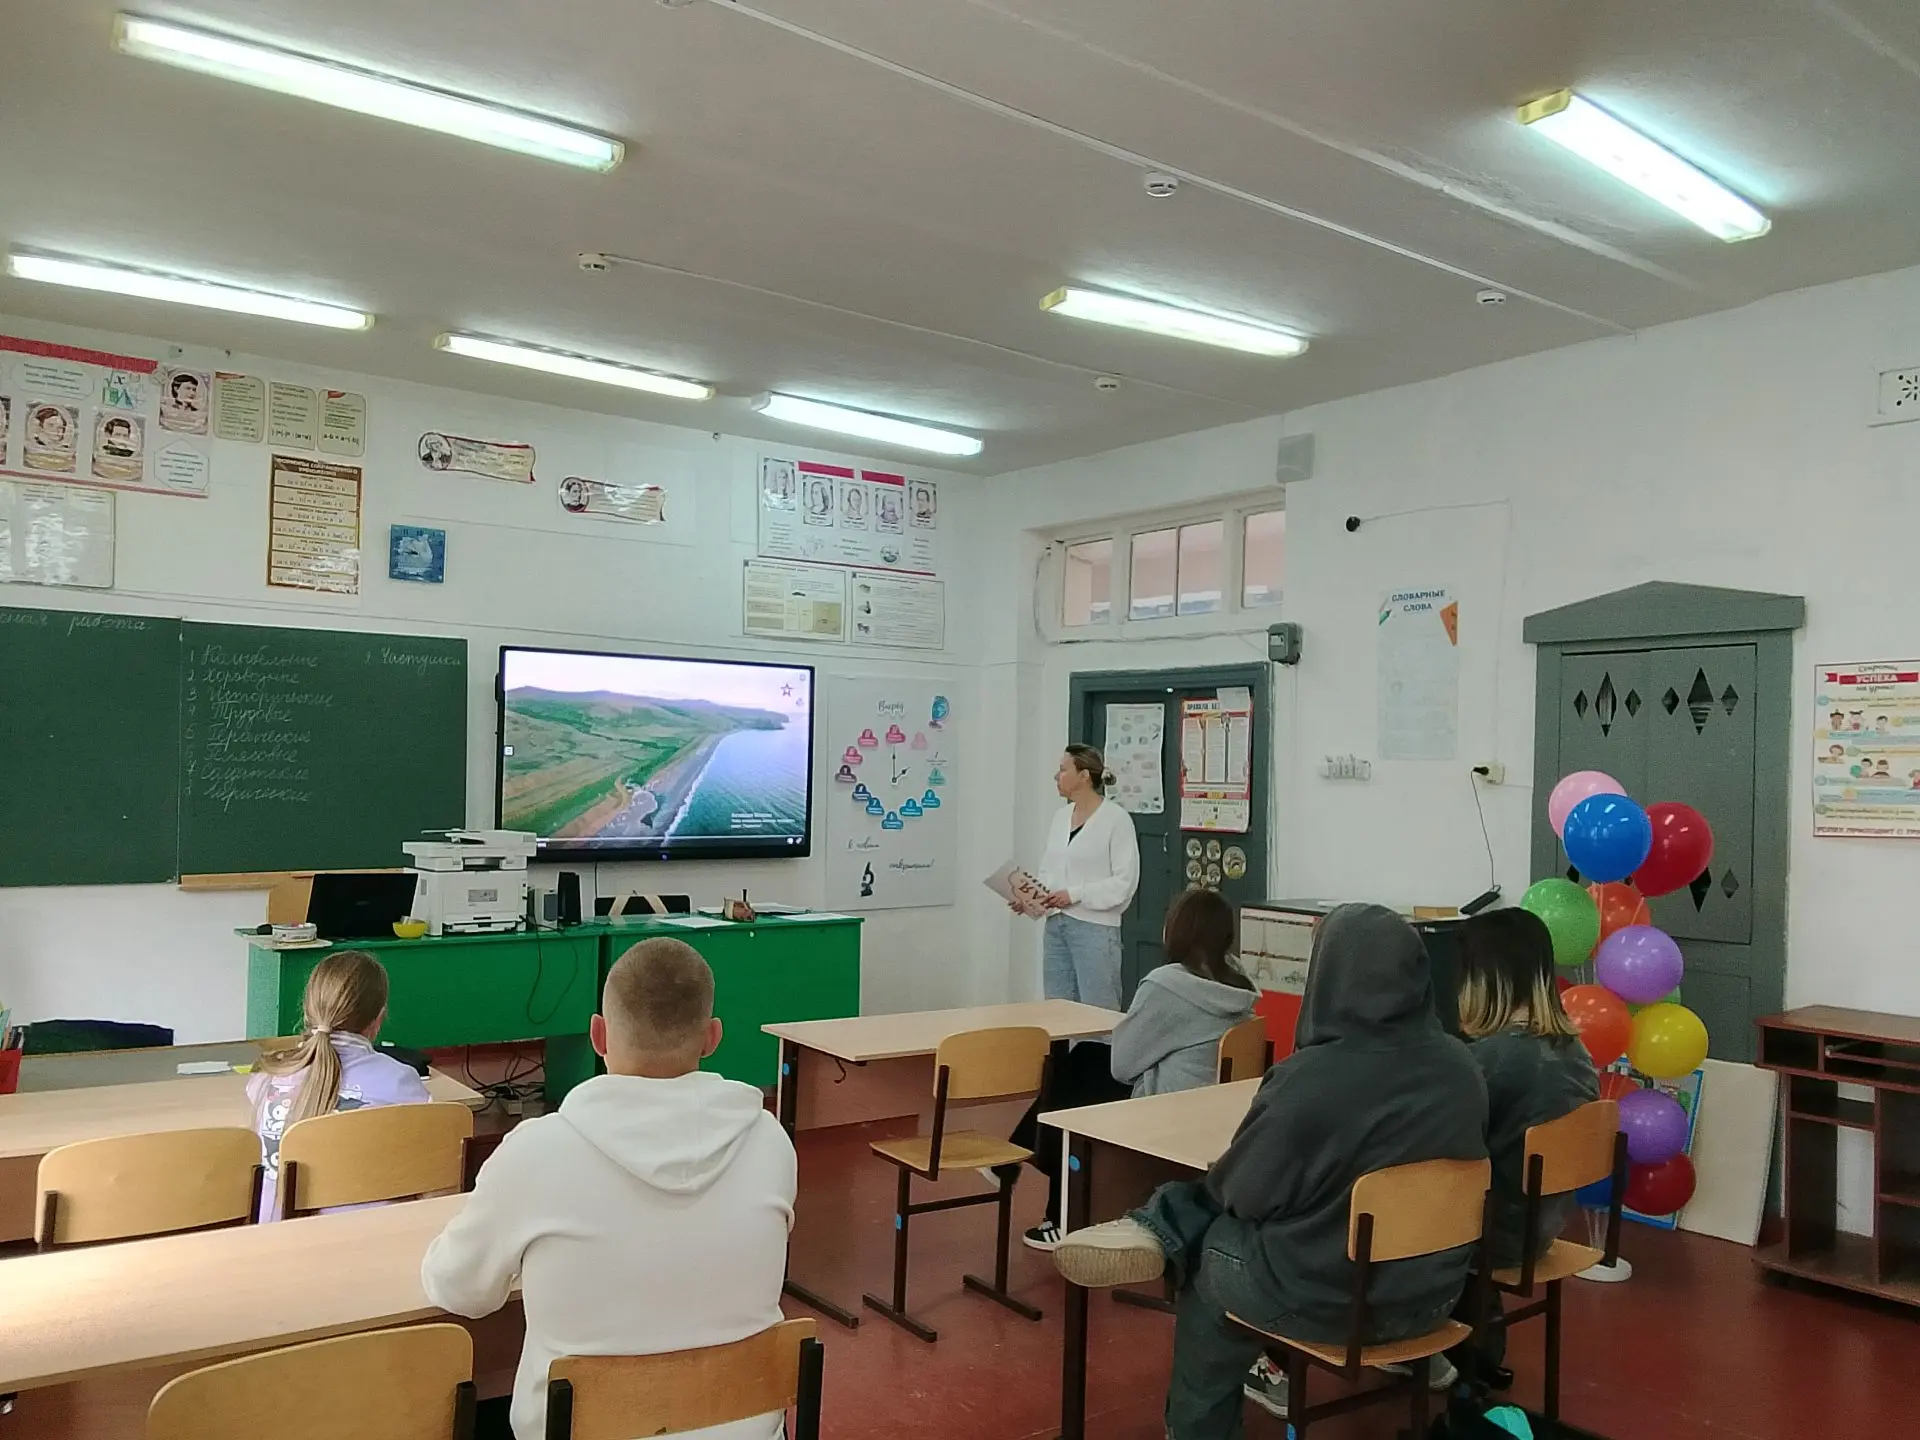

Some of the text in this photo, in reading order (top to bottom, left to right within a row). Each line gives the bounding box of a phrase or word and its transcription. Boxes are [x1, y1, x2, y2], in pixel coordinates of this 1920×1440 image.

[1391, 589, 1445, 602] СЛОВАРНЫЕ
[1403, 603, 1432, 612] СЛОВА
[1856, 674, 1898, 683] УСПЕХА
[187, 687, 199, 701] 3
